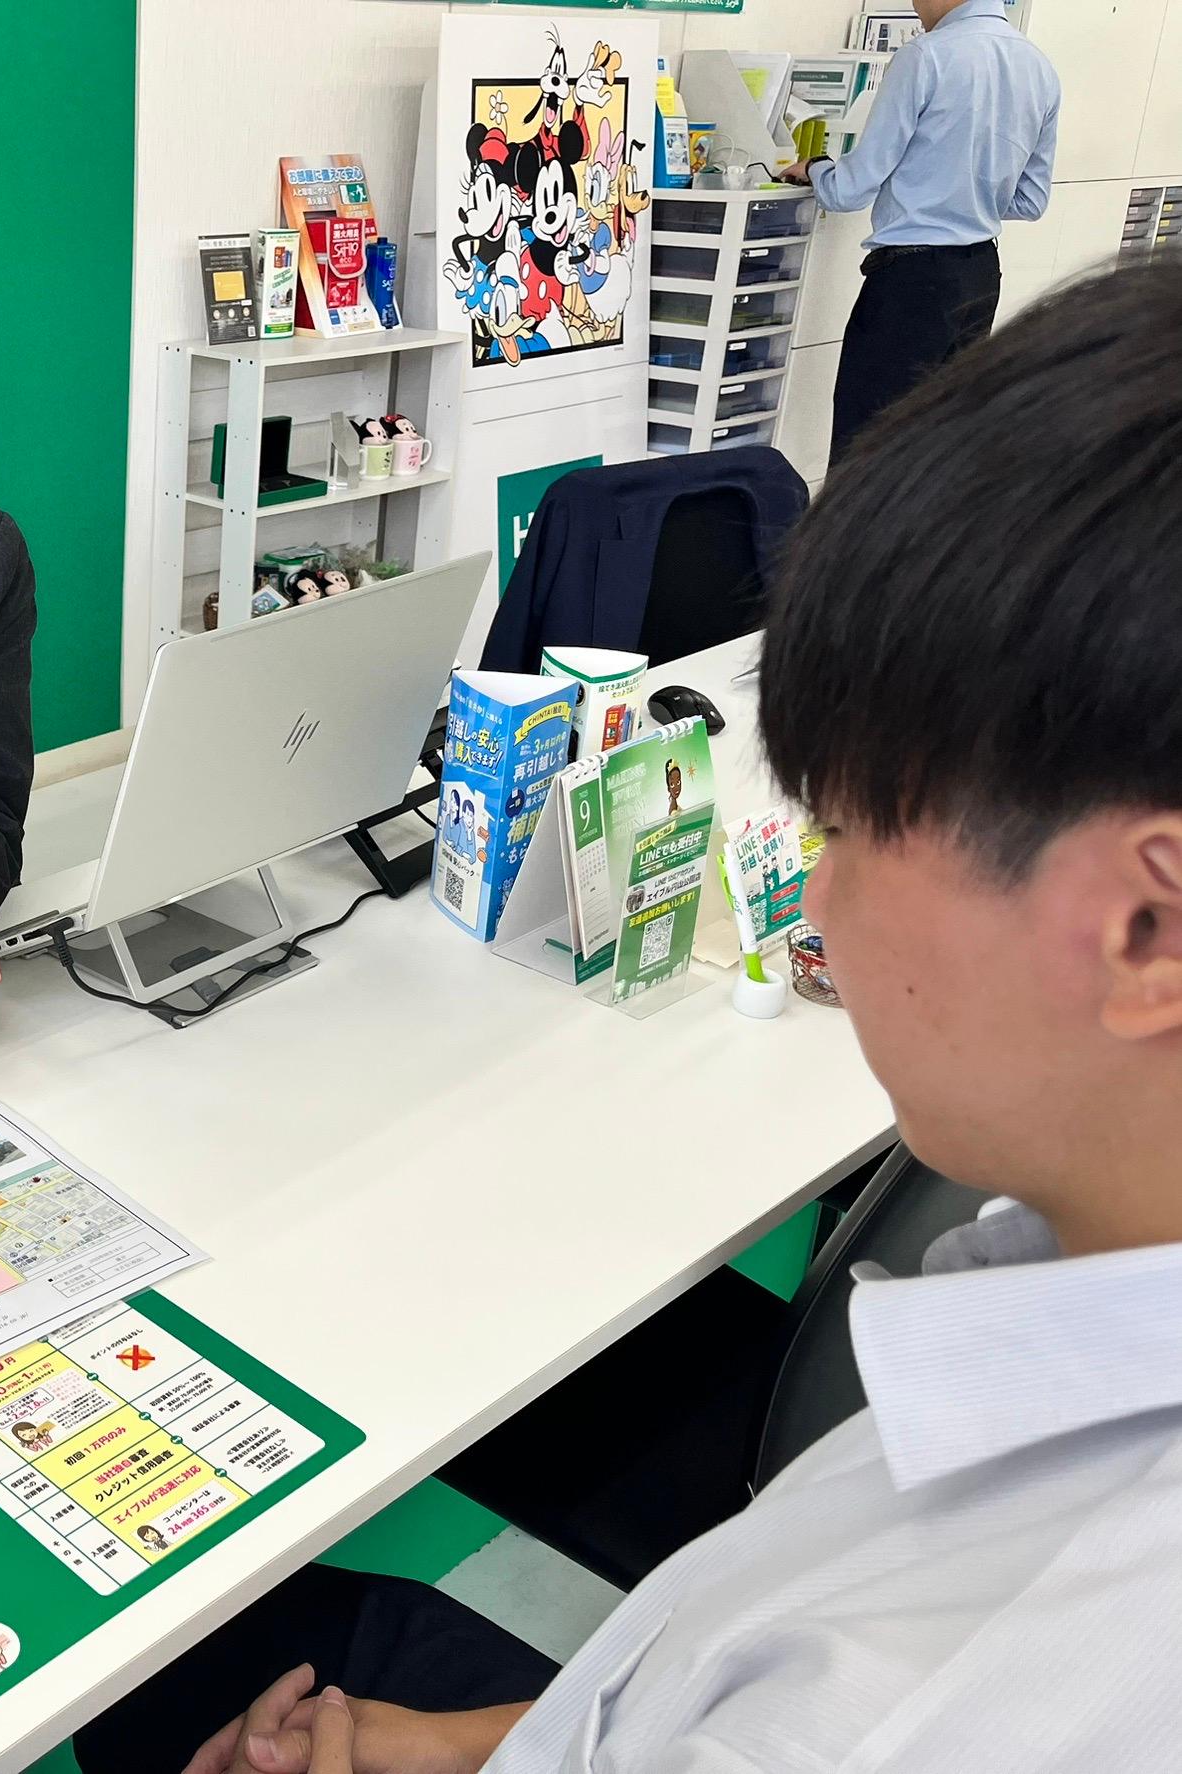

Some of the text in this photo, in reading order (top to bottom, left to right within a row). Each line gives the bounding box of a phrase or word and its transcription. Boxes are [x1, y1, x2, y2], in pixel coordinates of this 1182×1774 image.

[579, 800, 591, 832] 9
[639, 831, 703, 866] LINEでも受付中
[191, 1399, 241, 1433] 保証会社による審査
[63, 1425, 127, 1466] 初回1万円のみ
[10, 1471, 36, 1489] 保証会社
[94, 1447, 149, 1484] 当社独自審査
[94, 1449, 174, 1503] クレジット信用調査
[22, 1480, 37, 1490] への
[113, 1463, 202, 1524] エイブルが迅速に対応
[49, 1503, 75, 1522] 入居者様
[161, 1489, 211, 1523] コールセンターは
